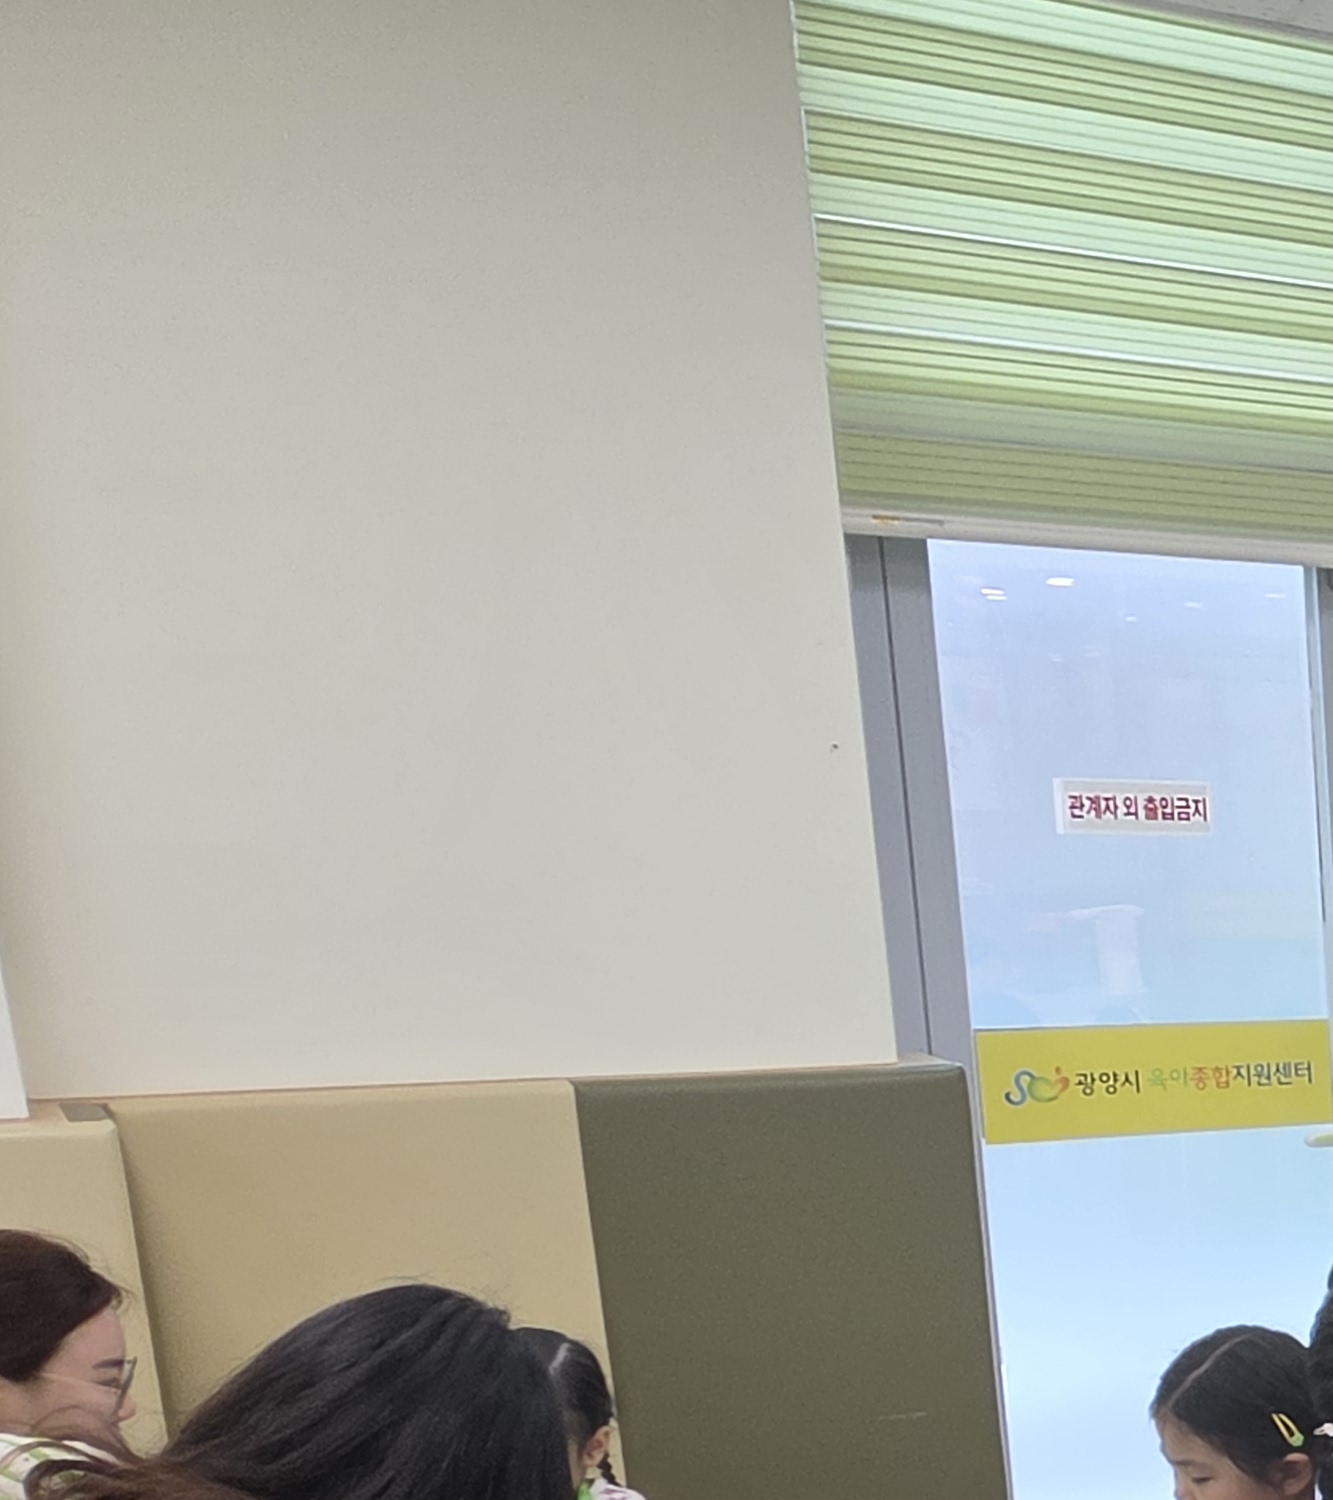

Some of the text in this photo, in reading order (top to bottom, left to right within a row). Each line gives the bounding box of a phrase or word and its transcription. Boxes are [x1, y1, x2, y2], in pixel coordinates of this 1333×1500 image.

[1068, 793, 1207, 822] 관계자 외 출입금지
[1074, 1060, 1313, 1097] 광양시 육아종합지원센터
